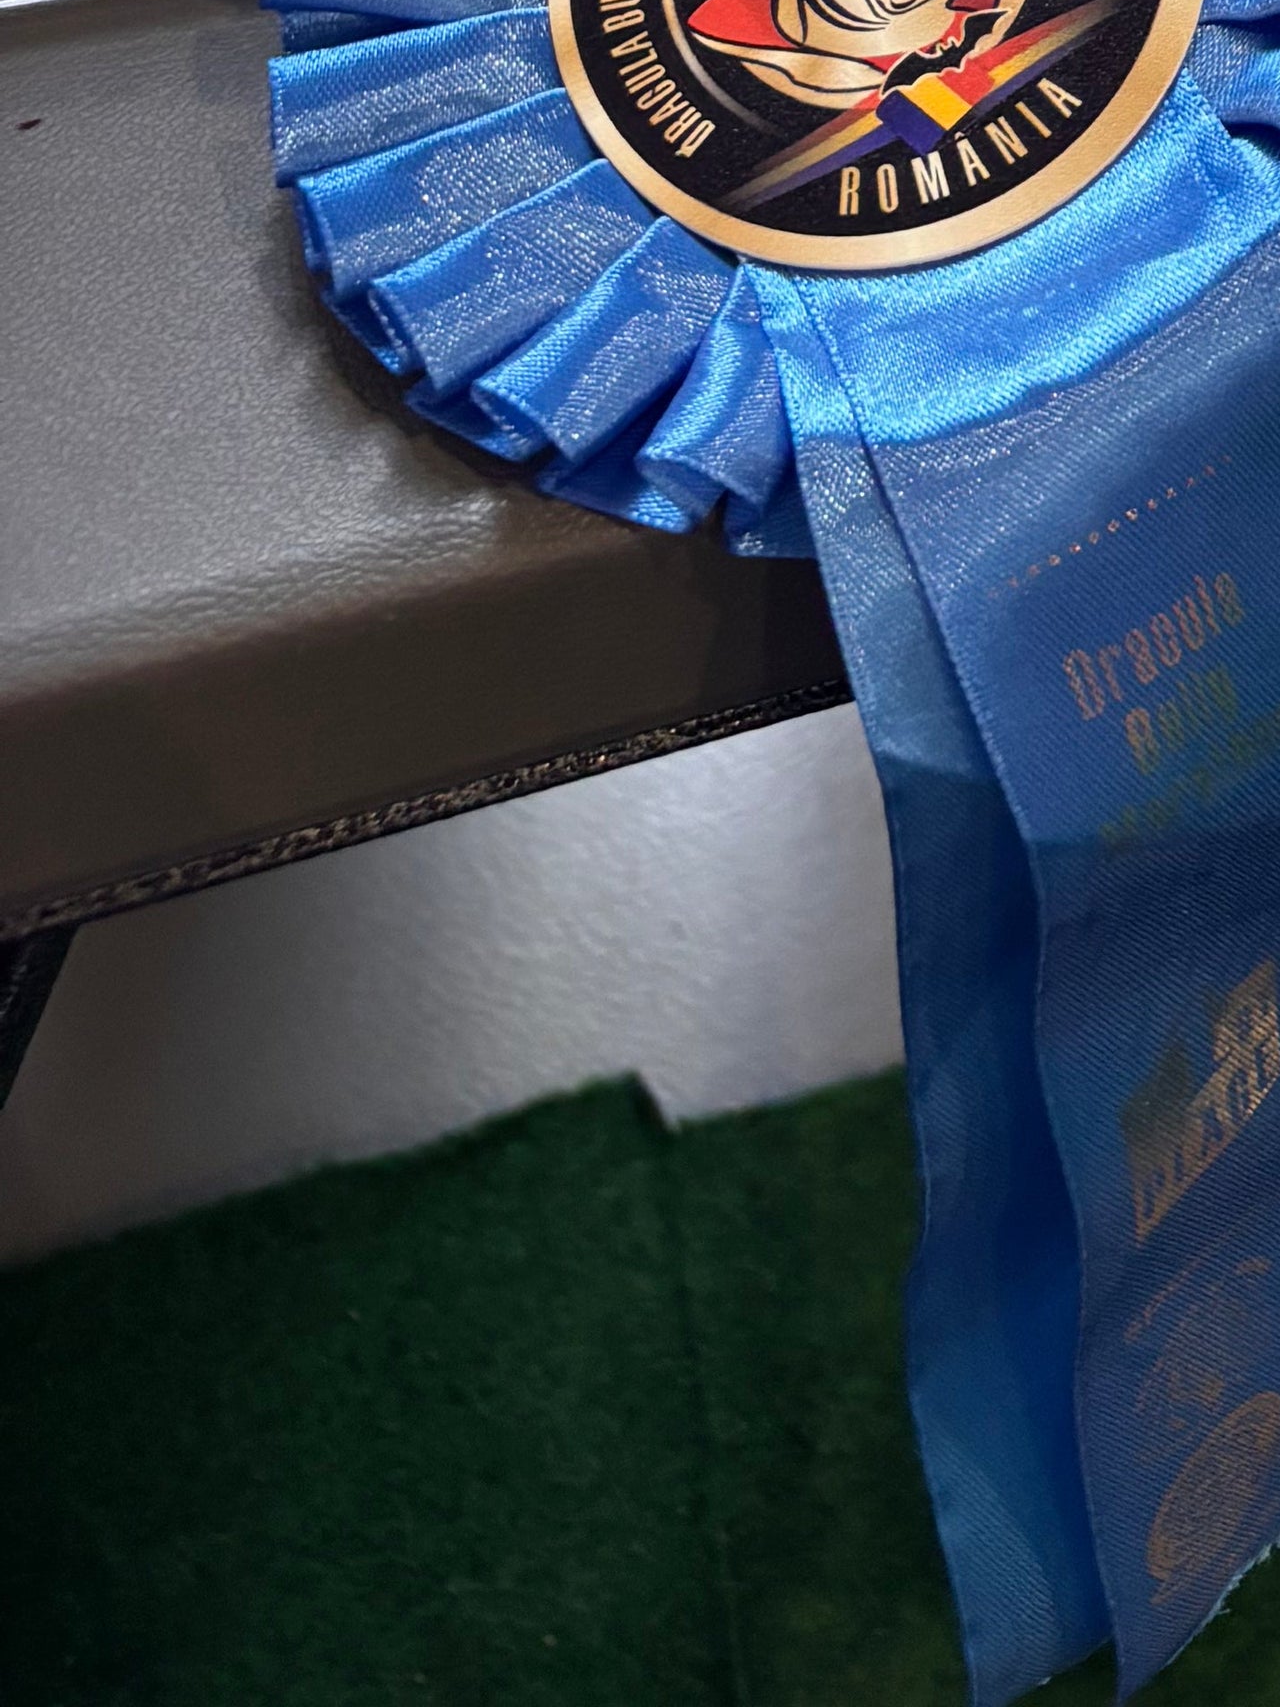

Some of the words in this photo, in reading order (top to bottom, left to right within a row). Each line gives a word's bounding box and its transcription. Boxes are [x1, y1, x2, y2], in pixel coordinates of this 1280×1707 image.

[609, 30, 717, 159] DRACULA
[838, 77, 1084, 218] ROMÂNIA
[1062, 571, 1247, 723] Dracula
